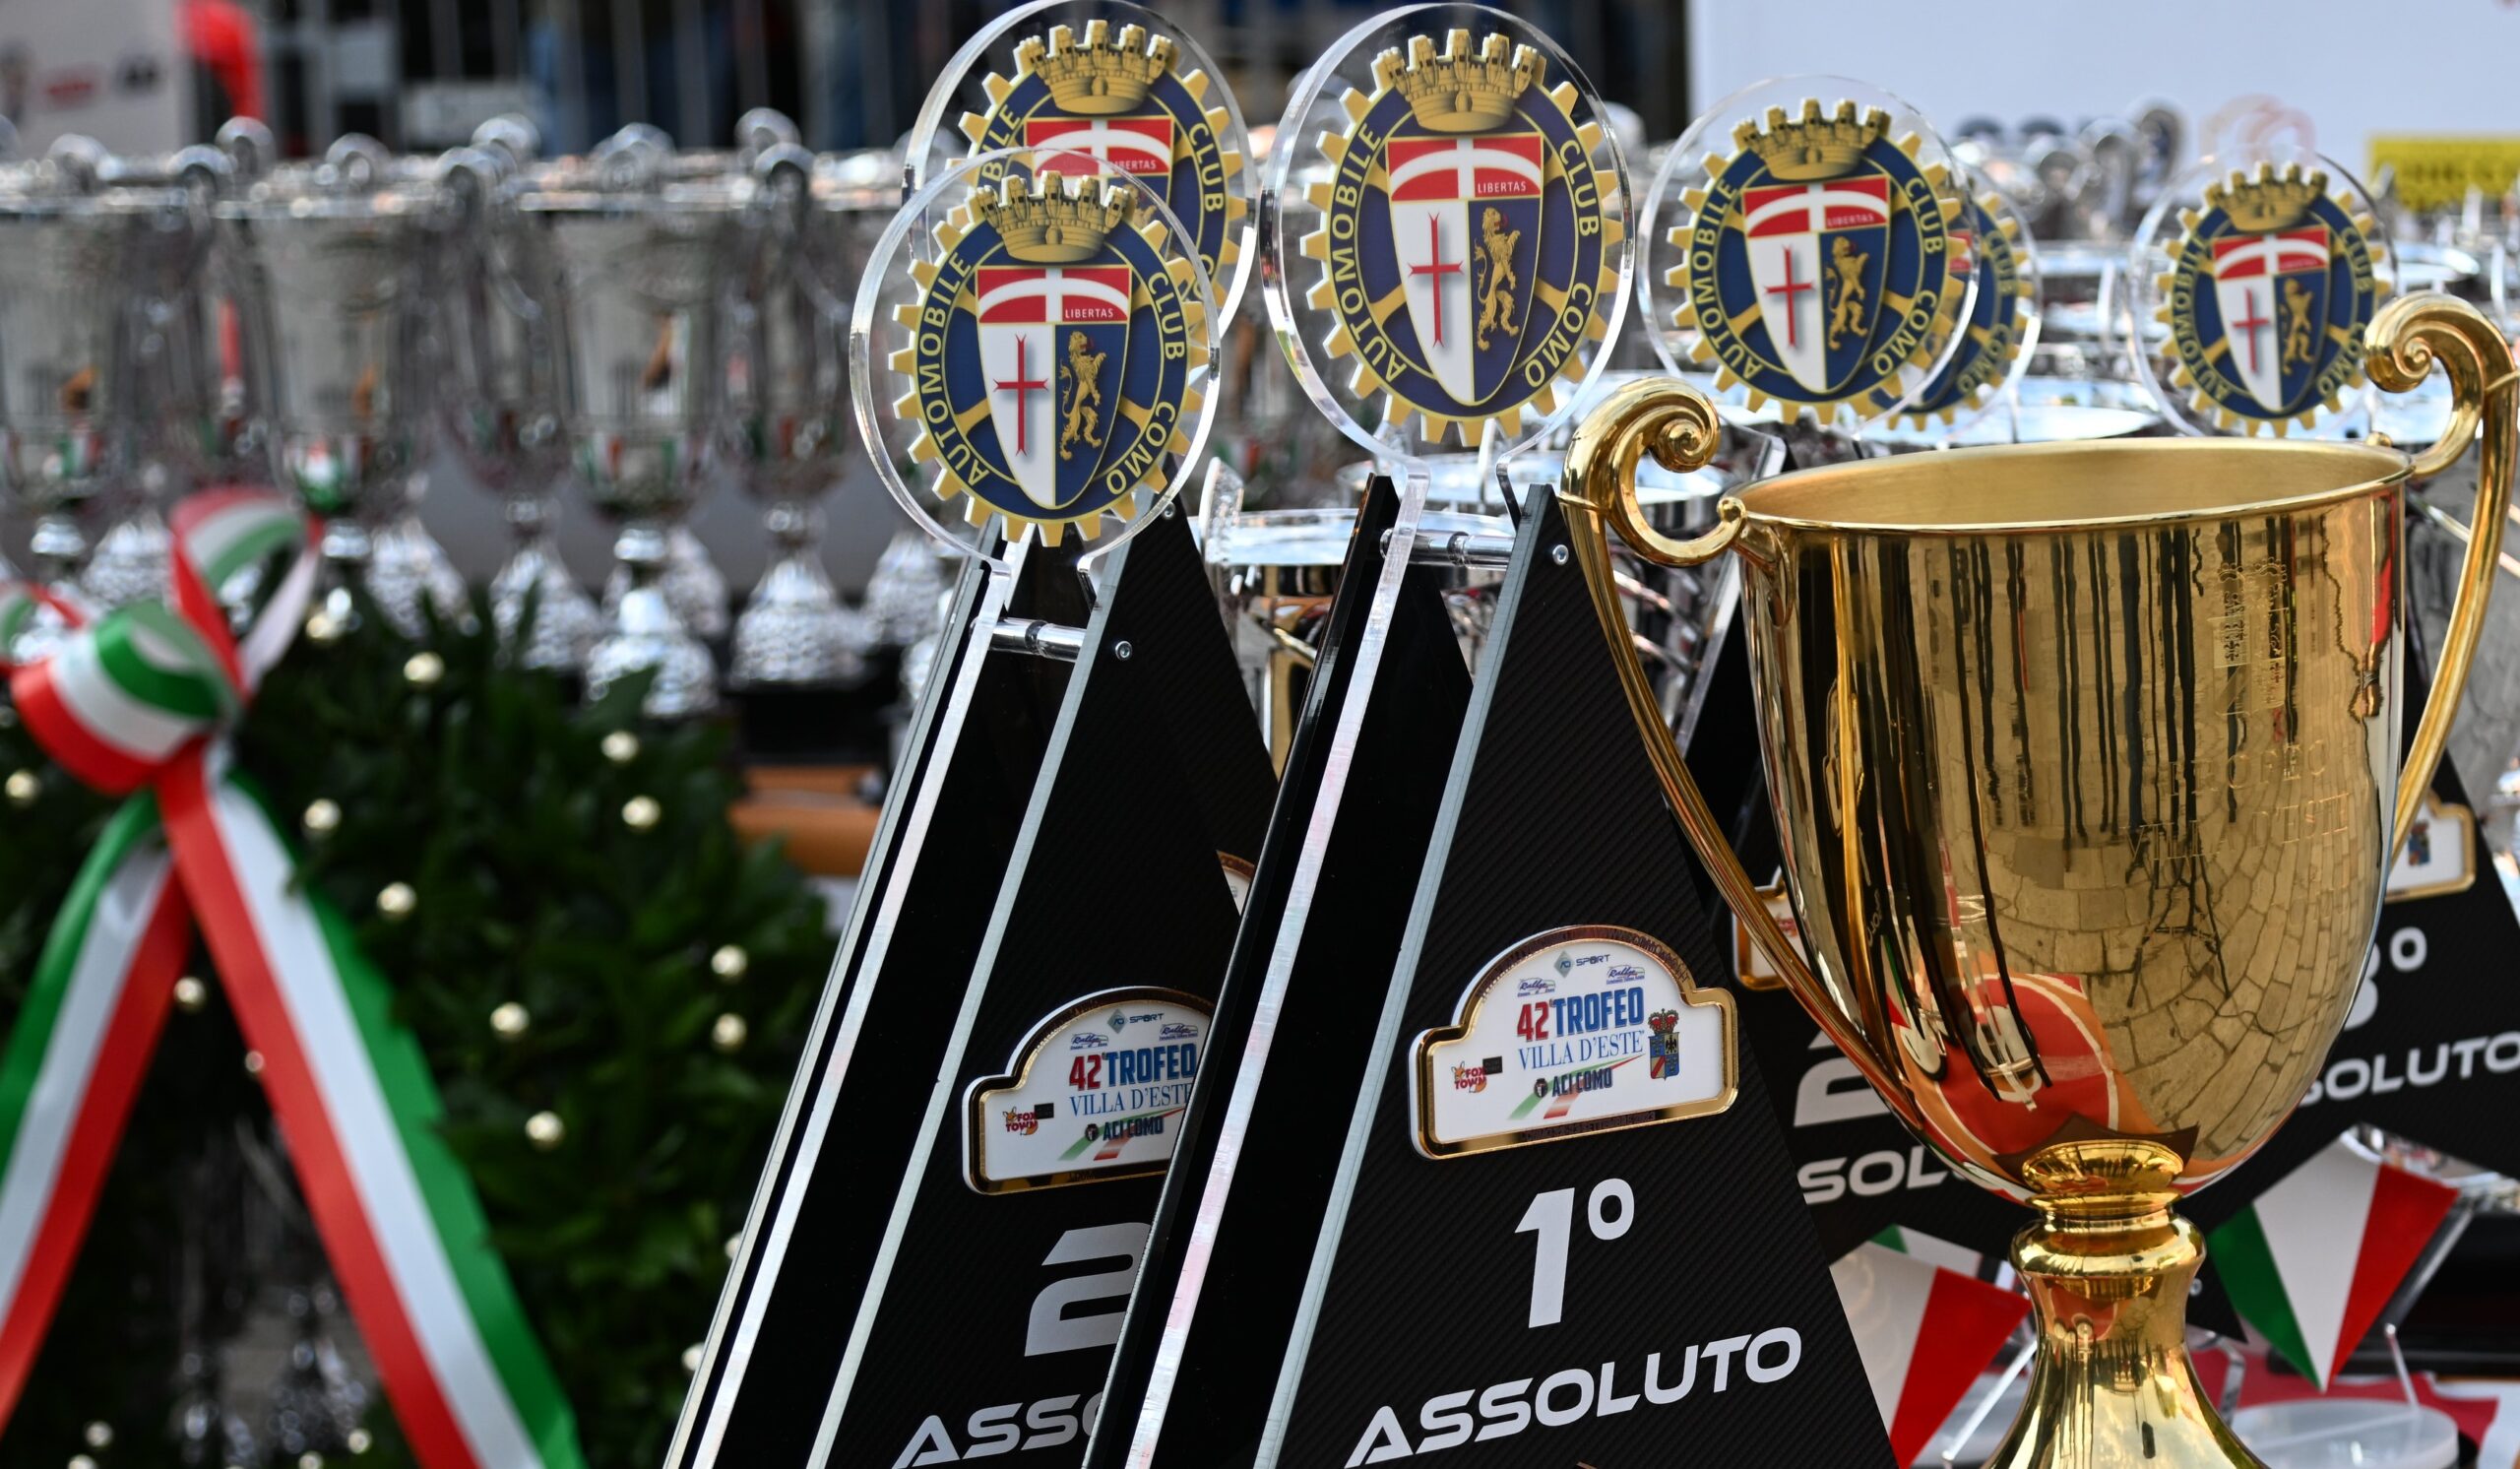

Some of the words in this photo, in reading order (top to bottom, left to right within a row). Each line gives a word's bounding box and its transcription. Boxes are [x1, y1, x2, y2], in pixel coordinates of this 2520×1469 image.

[1189, 123, 1225, 212] CLUB
[1478, 181, 1527, 194] LIBERTAS
[1560, 139, 1600, 236] CLUB
[1827, 214, 1875, 227] LIBERTAS
[1905, 177, 1942, 254] CLUB
[1332, 123, 1407, 382] AUTOMOBILE
[1692, 178, 1764, 380] AUTOMOBILE
[1065, 307, 1114, 319] LIBERTAS
[1148, 272, 1185, 359] CLUB
[1525, 283, 1593, 387] COMO
[1873, 289, 1937, 377] COMO
[919, 251, 989, 485] AUTOMOBILE
[1106, 402, 1175, 494] COMO
[1576, 954, 1611, 966] SPORT
[1129, 1012, 1165, 1024] SPORT
[1552, 986, 1645, 1037] TROFEO
[1104, 1042, 1198, 1087] TROFEO
[1465, 1066, 1487, 1078] FOX
[1517, 1044, 1574, 1070] VILLA
[1579, 1031, 1645, 1062] D'ESTE
[1070, 1090, 1126, 1117] VILLA
[1454, 1076, 1487, 1090] TOWN
[1551, 1074, 1575, 1098] ACI
[1574, 1067, 1614, 1094] COMO
[1102, 1119, 1126, 1141] ACI
[1126, 1115, 1165, 1137] COMO
[1344, 1326, 1802, 1469] ASSOLUTO
